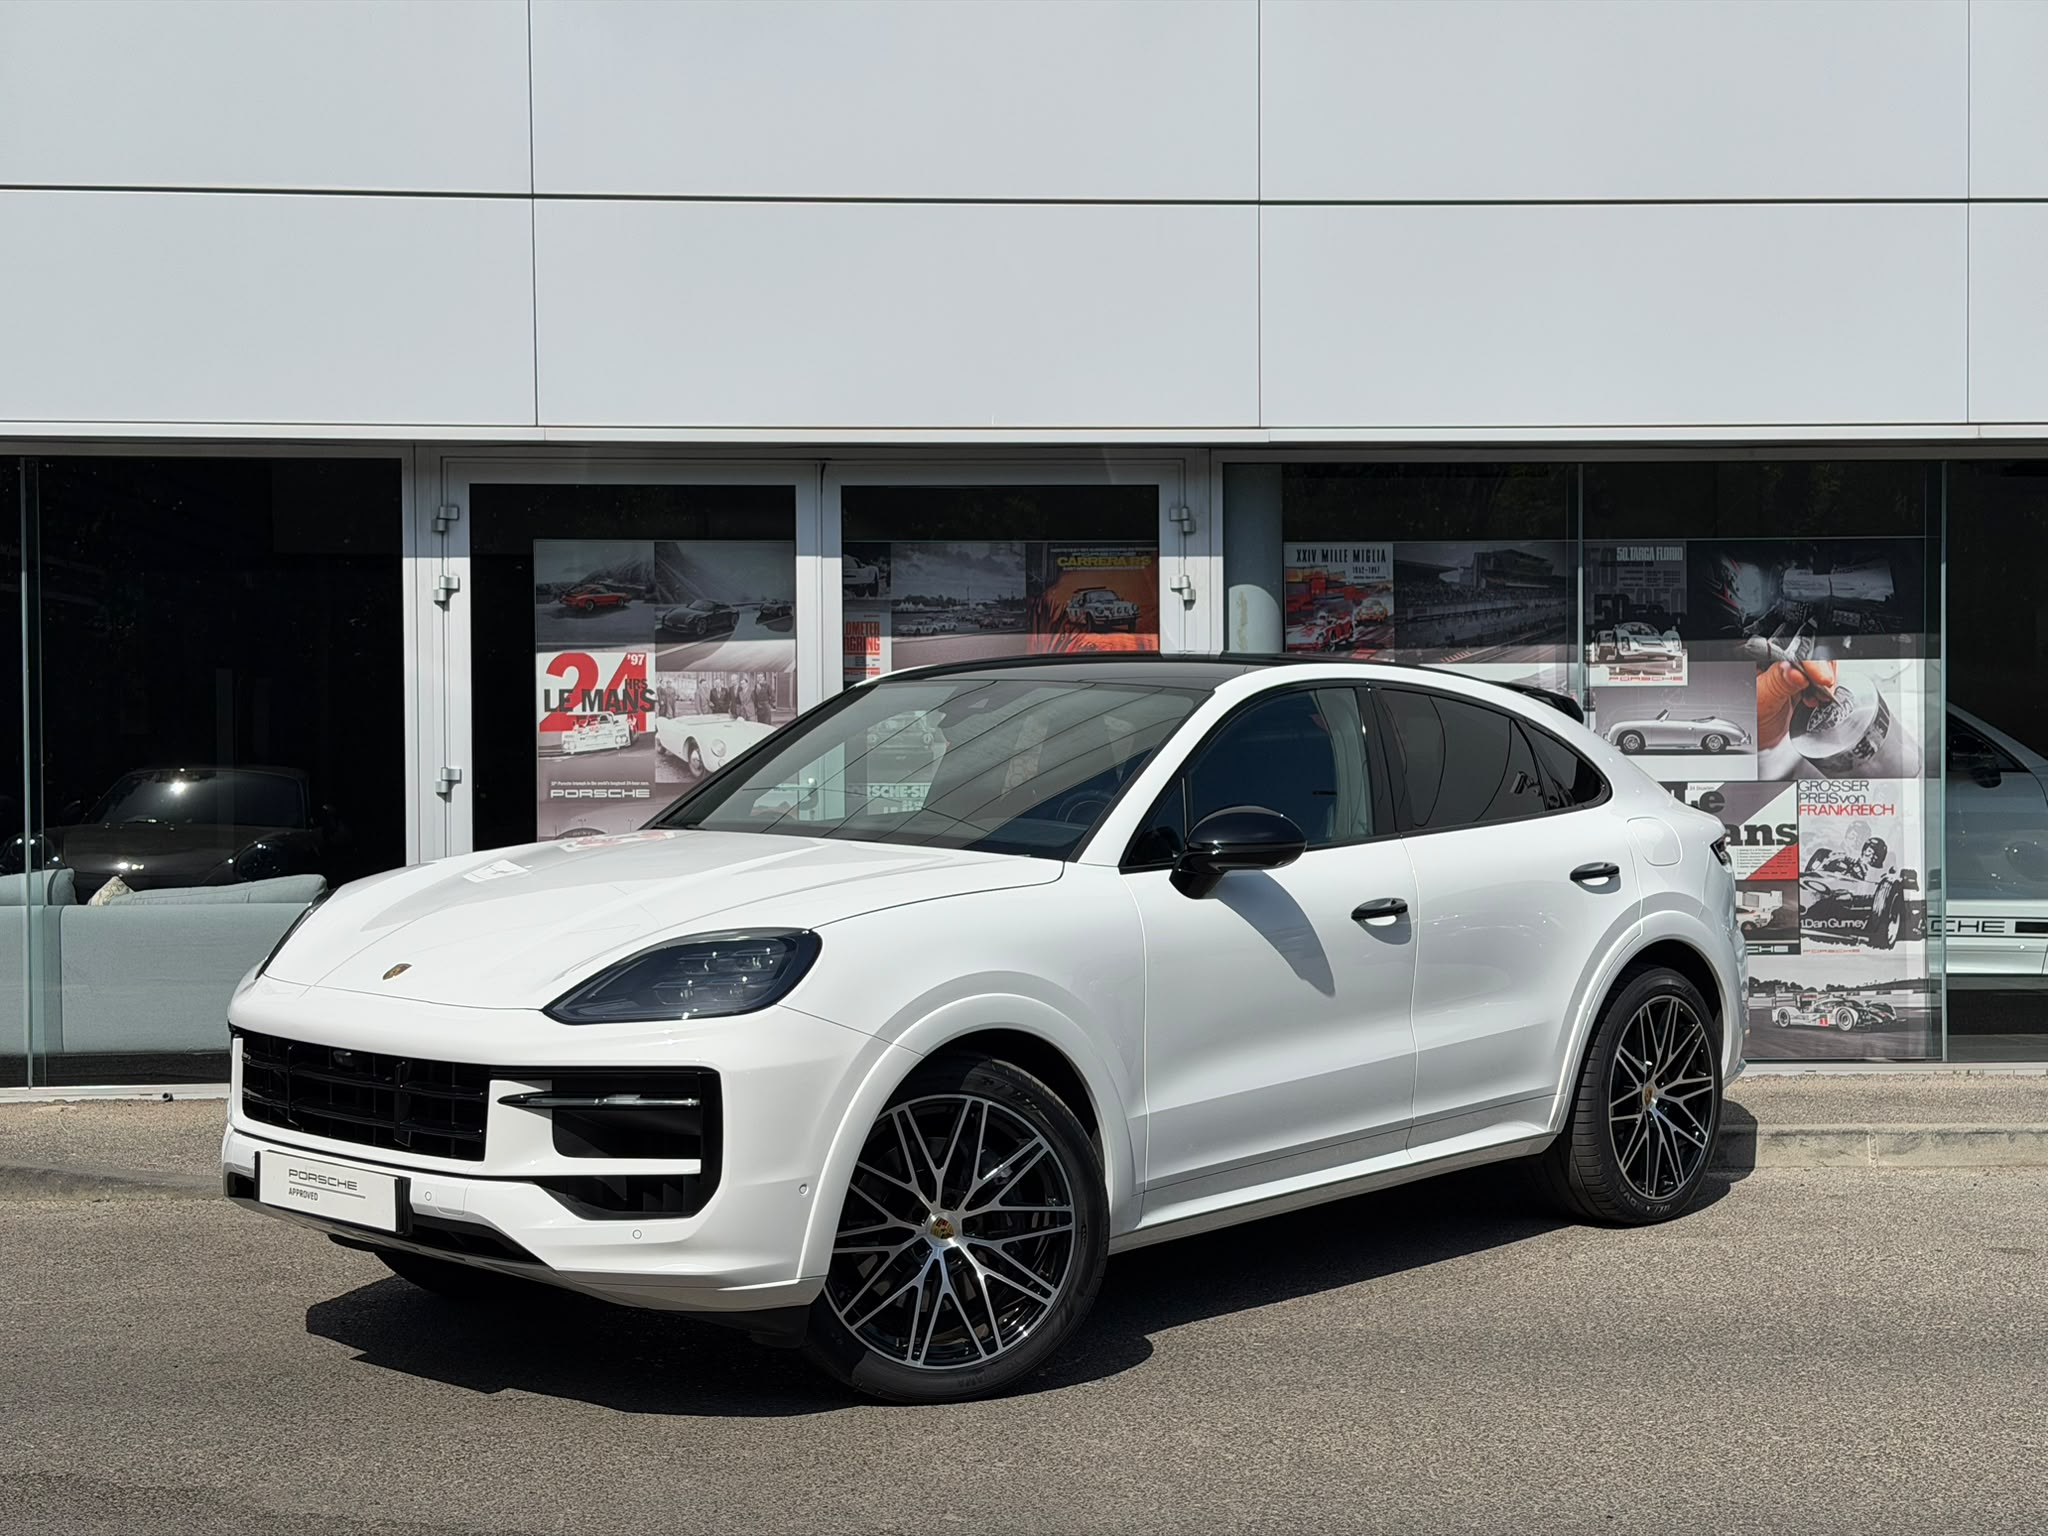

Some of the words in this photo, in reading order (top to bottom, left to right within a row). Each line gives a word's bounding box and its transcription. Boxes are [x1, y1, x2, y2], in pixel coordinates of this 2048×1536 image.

[1057, 556, 1126, 567] CARRERA
[1297, 549, 1317, 563] XXIV
[1321, 549, 1348, 563] MILLE
[1353, 549, 1386, 563] MIGLIA
[627, 654, 646, 666] '97
[624, 678, 648, 690] HRS
[539, 652, 647, 733] 24
[544, 689, 574, 713] LE
[581, 688, 660, 713] MANS
[1798, 780, 1869, 792] GROSSER
[550, 789, 650, 799] PORSCHE
[1799, 804, 1895, 816] FRANKREICH
[1828, 918, 1869, 930] Gurney
[1931, 920, 2006, 933] CHE
[289, 1168, 358, 1191] PORSCHE
[288, 1187, 319, 1201] APPROVED
